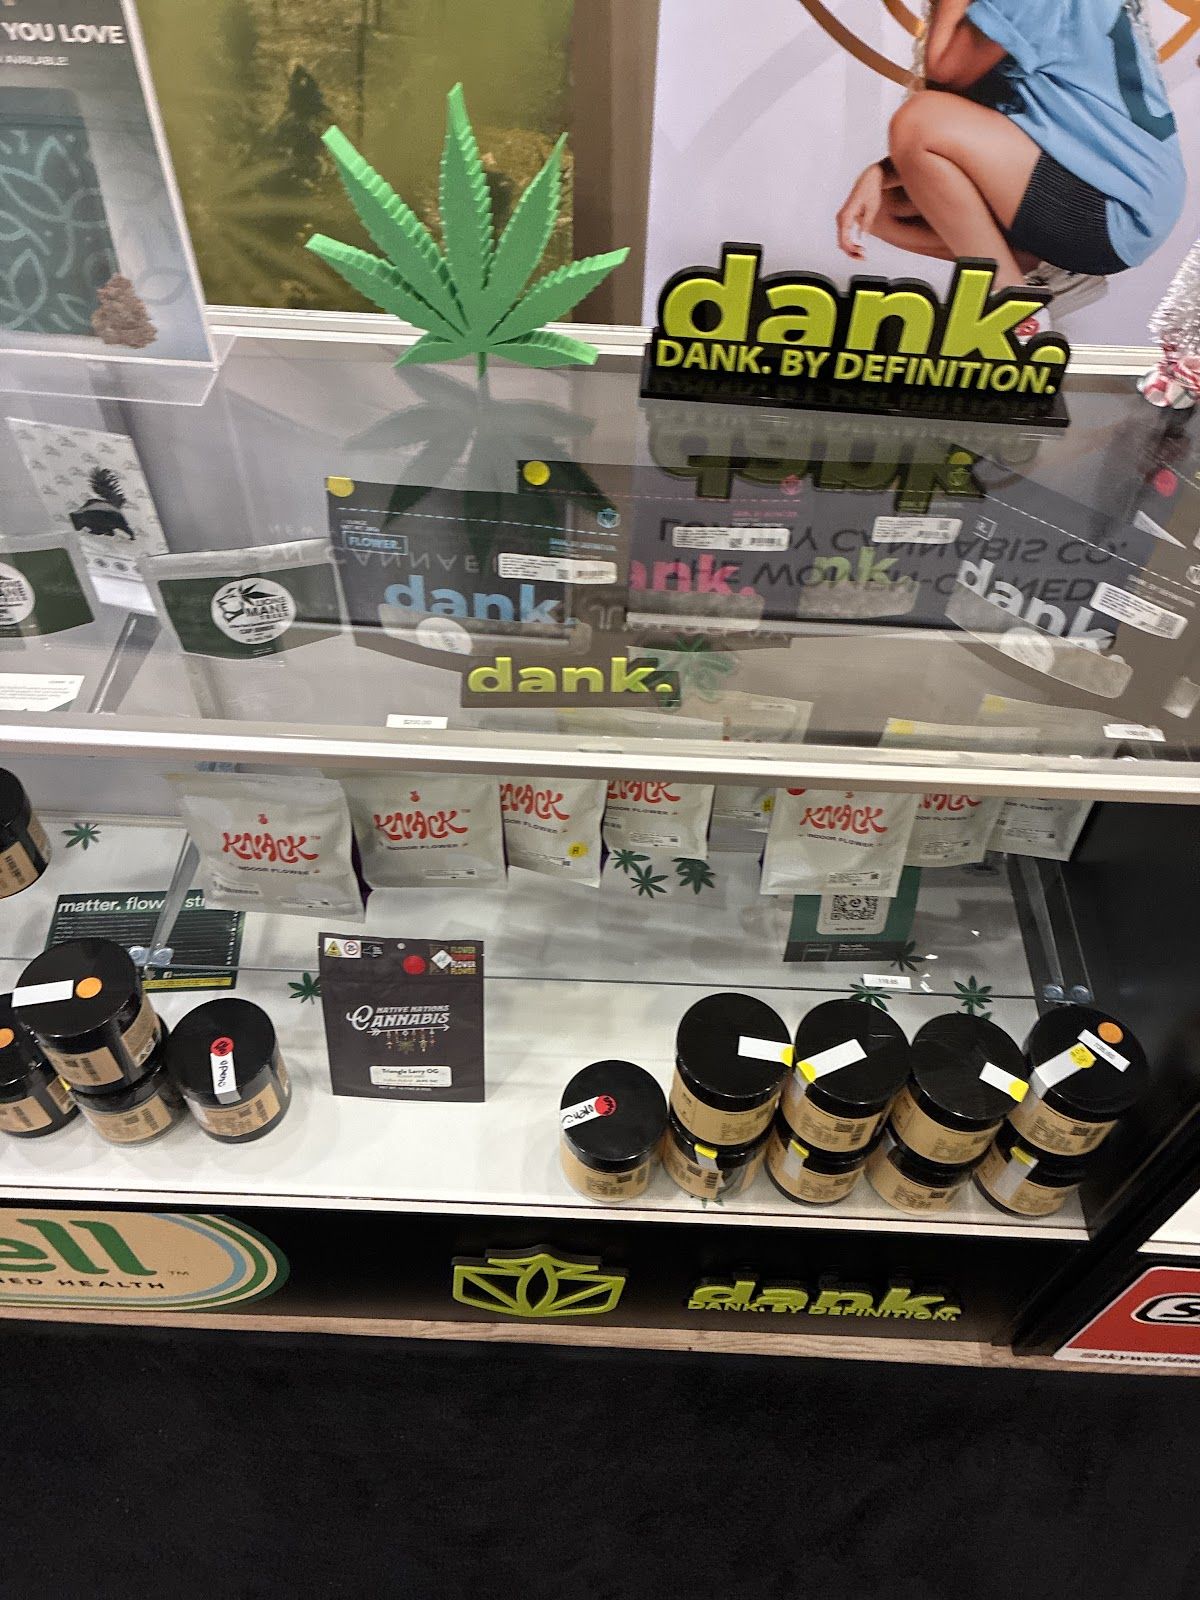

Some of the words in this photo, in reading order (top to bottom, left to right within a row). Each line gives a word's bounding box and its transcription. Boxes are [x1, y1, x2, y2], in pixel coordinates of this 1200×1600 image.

[0, 22, 55, 42] YOU
[58, 23, 127, 44] LOVE
[656, 340, 772, 375] DANK.
[779, 349, 831, 380] BY
[833, 351, 1056, 395] DEFINITION.
[467, 656, 674, 694] dank.
[373, 810, 469, 841] KNACK
[800, 804, 889, 835] KNACK
[222, 832, 319, 864] KNACK
[58, 900, 121, 913] matter.
[126, 896, 166, 911] flow
[346, 1005, 450, 1031] CANNABIS
[376, 1006, 410, 1014] NATIVE
[410, 1005, 450, 1013] NATIONS
[58, 1279, 166, 1290] HEALTH
[687, 1299, 766, 1313] DANK.
[771, 1303, 801, 1314] BY
[808, 1304, 957, 1321] DEFINITION.
